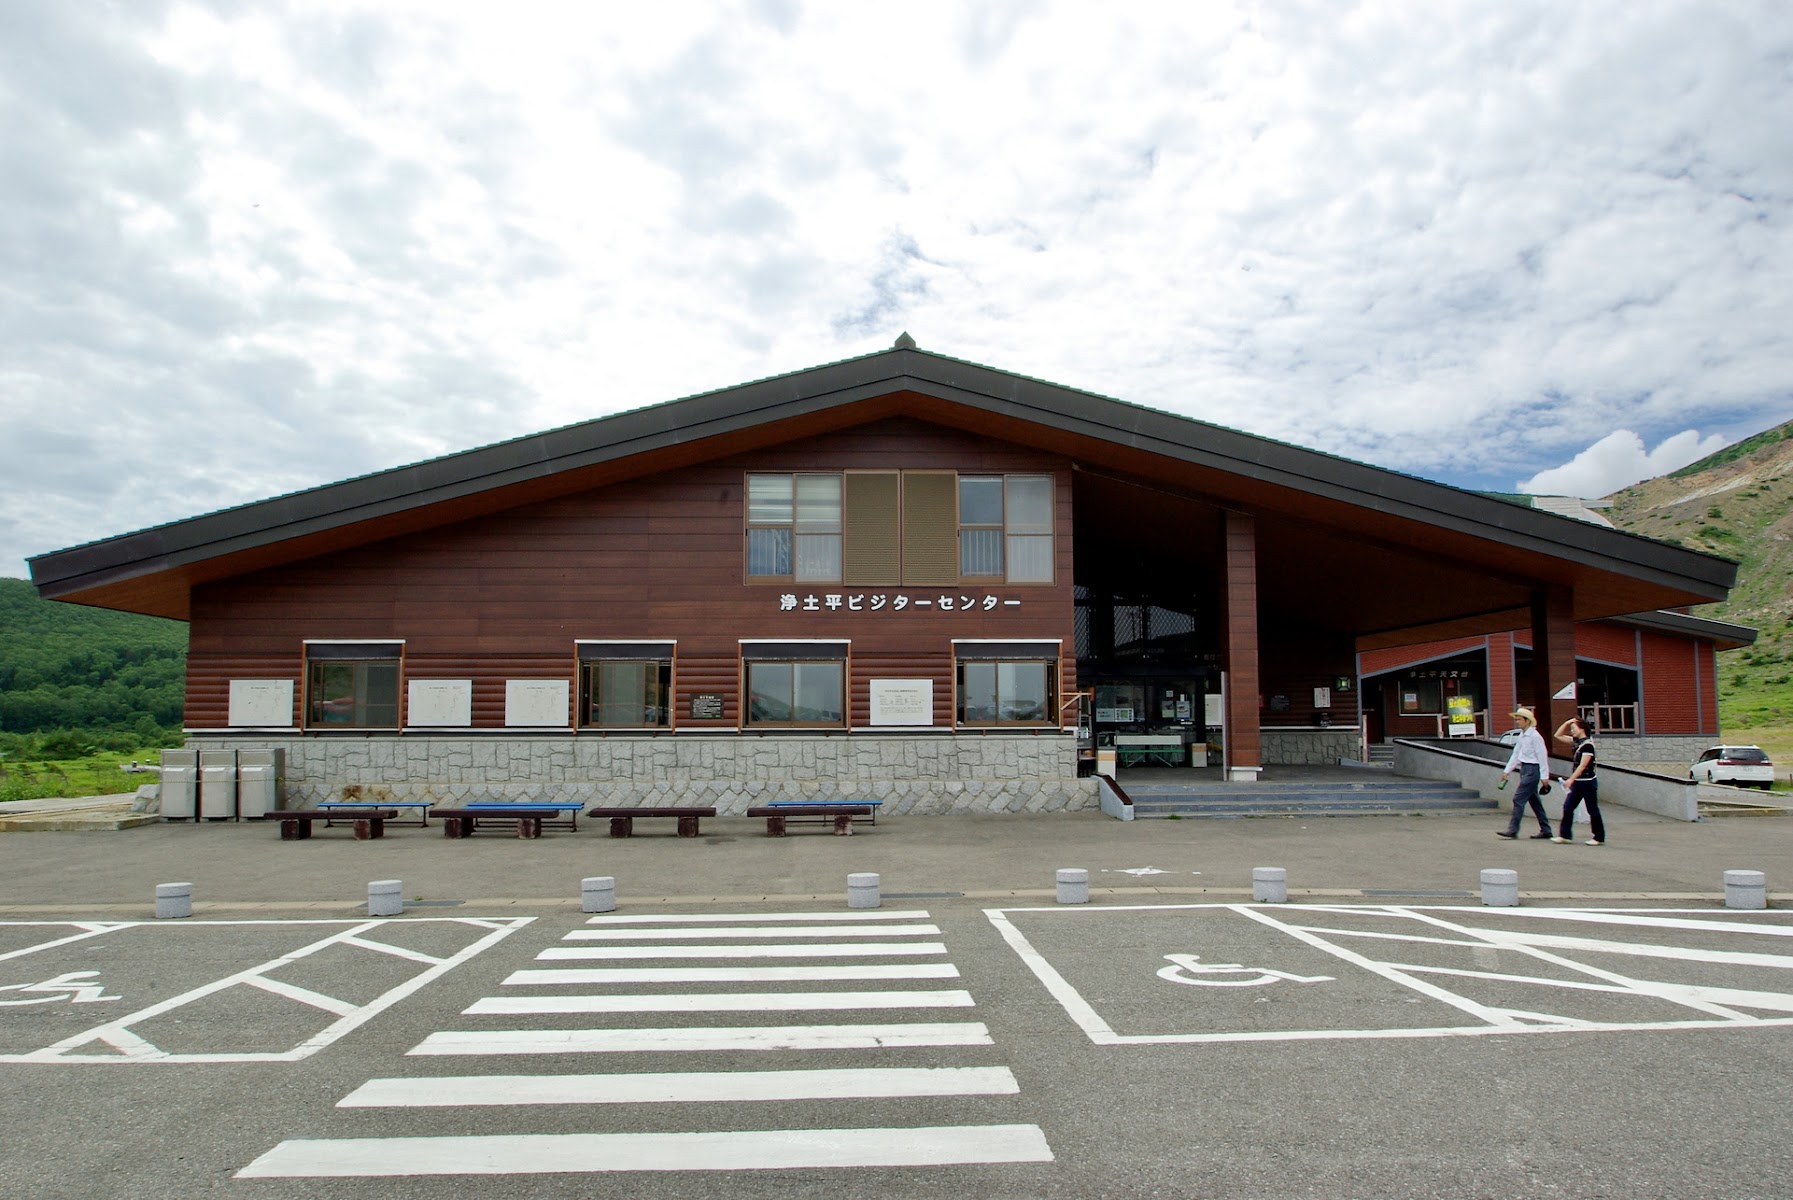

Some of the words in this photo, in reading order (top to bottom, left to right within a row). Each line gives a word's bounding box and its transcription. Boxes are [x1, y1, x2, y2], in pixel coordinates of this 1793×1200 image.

[780, 594, 1021, 611] 浄土平ビジターセンター
